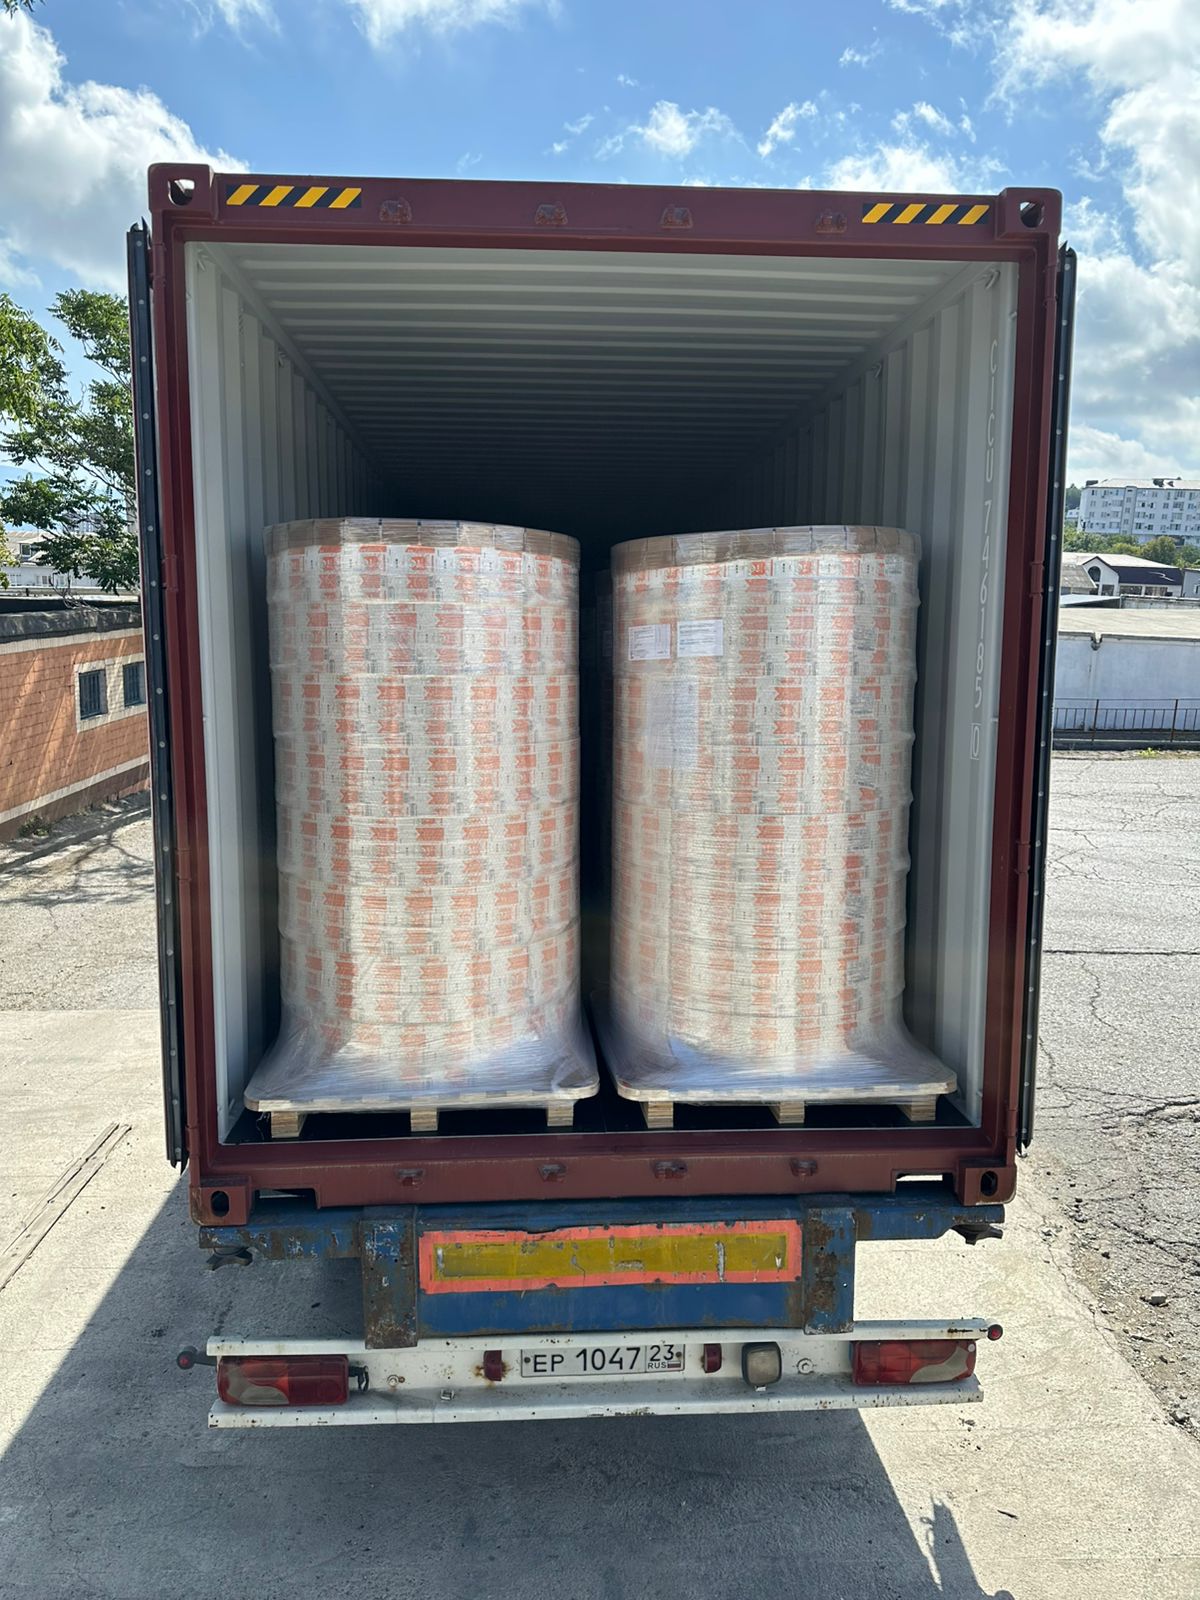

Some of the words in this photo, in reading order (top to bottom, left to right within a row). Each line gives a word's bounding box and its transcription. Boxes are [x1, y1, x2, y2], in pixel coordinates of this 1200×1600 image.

[986, 339, 998, 482] CICU
[975, 500, 992, 708] 746185
[972, 725, 980, 758] 0
[533, 1354, 564, 1373] EP
[576, 1347, 641, 1371] 1047
[650, 1345, 674, 1362] 23
